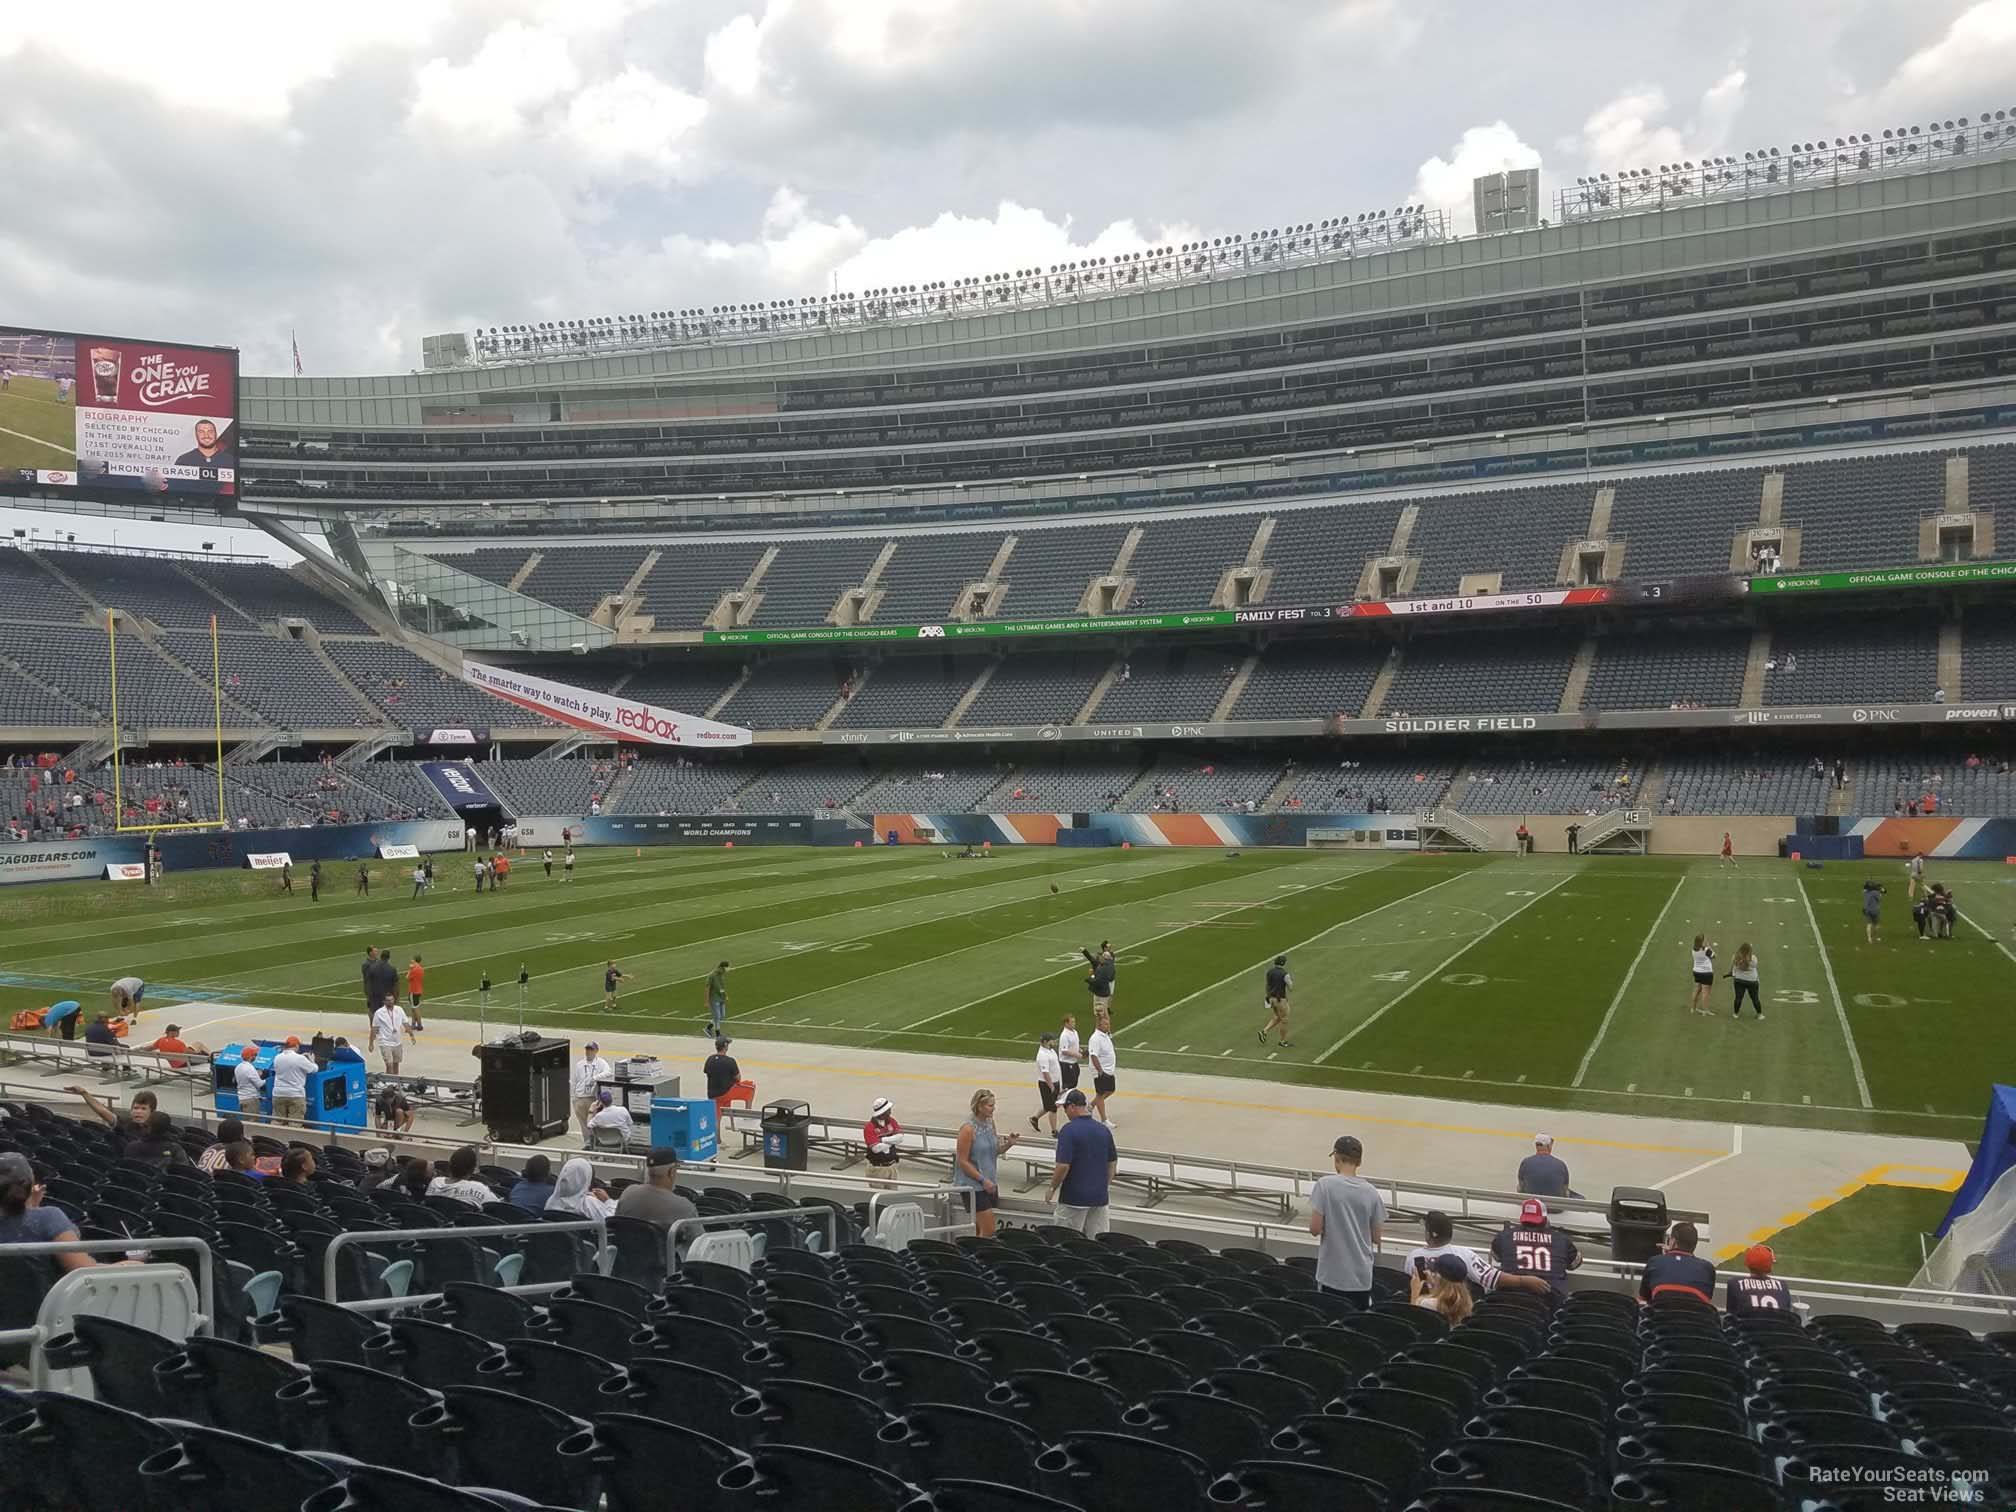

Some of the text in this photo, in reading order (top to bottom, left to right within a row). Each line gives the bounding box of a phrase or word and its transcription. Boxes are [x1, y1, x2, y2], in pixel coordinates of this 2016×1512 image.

[140, 354, 163, 366] THE
[131, 362, 175, 384] ONE
[175, 366, 198, 377] YOU
[146, 374, 210, 399] CRAVE
[84, 411, 149, 423] BIOGRAPHY
[84, 423, 128, 432] SELECTED
[142, 427, 180, 436] CHICAGO
[97, 432, 113, 440] THE
[135, 435, 164, 443] ROUND
[84, 440, 109, 449] (71ST
[112, 442, 153, 452] OVERALL)
[162, 467, 199, 477] GRASU
[202, 469, 216, 478] OL
[220, 470, 233, 479] 55
[1849, 574, 1887, 583] OFFICIAL
[1888, 573, 1913, 582] GAME
[1915, 571, 1956, 580] CONSOLE
[1957, 569, 1971, 578] OF
[1972, 568, 1989, 577] THE
[1652, 587, 1661, 597] 3
[1409, 598, 1473, 612] 1st and 10
[1526, 594, 1542, 604] 50
[1235, 610, 1275, 622] FAMILY
[1278, 608, 1306, 620] FEST
[1324, 608, 1331, 618] 3
[1016, 623, 1044, 631] ULTIMATE
[1045, 622, 1065, 630] GAMES
[1066, 621, 1080, 629] AND
[1090, 619, 1138, 628] ENTERTAINMENT
[1138, 618, 1163, 626] SYSTEM
[791, 632, 807, 640] GAME
[808, 631, 833, 639] CONSOLE
[842, 630, 853, 638] THE
[854, 629, 879, 638] CHICAGO
[880, 629, 897, 637] BEARS
[471, 668, 613, 721] The smarter way to watch & play.
[1748, 711, 1770, 724] Lite
[1869, 710, 1900, 721] PNC
[1945, 707, 1998, 720] proven
[1183, 727, 1205, 736] PNC
[1386, 718, 1537, 733] SOLDIER FIELD
[697, 731, 737, 740] redbox.com
[840, 733, 869, 743] xfinity
[1094, 729, 1131, 737] UNITED
[1625, 812, 1638, 823] 4E
[447, 830, 460, 839] GSH
[521, 828, 534, 836] GSH
[254, 855, 285, 868] meijer
[1512, 1231, 1552, 1244] SINGLETARY
[1516, 1245, 1551, 1271] 50
[1472, 1258, 1490, 1274] 34
[1737, 1278, 1783, 1291] TRUBISKY
